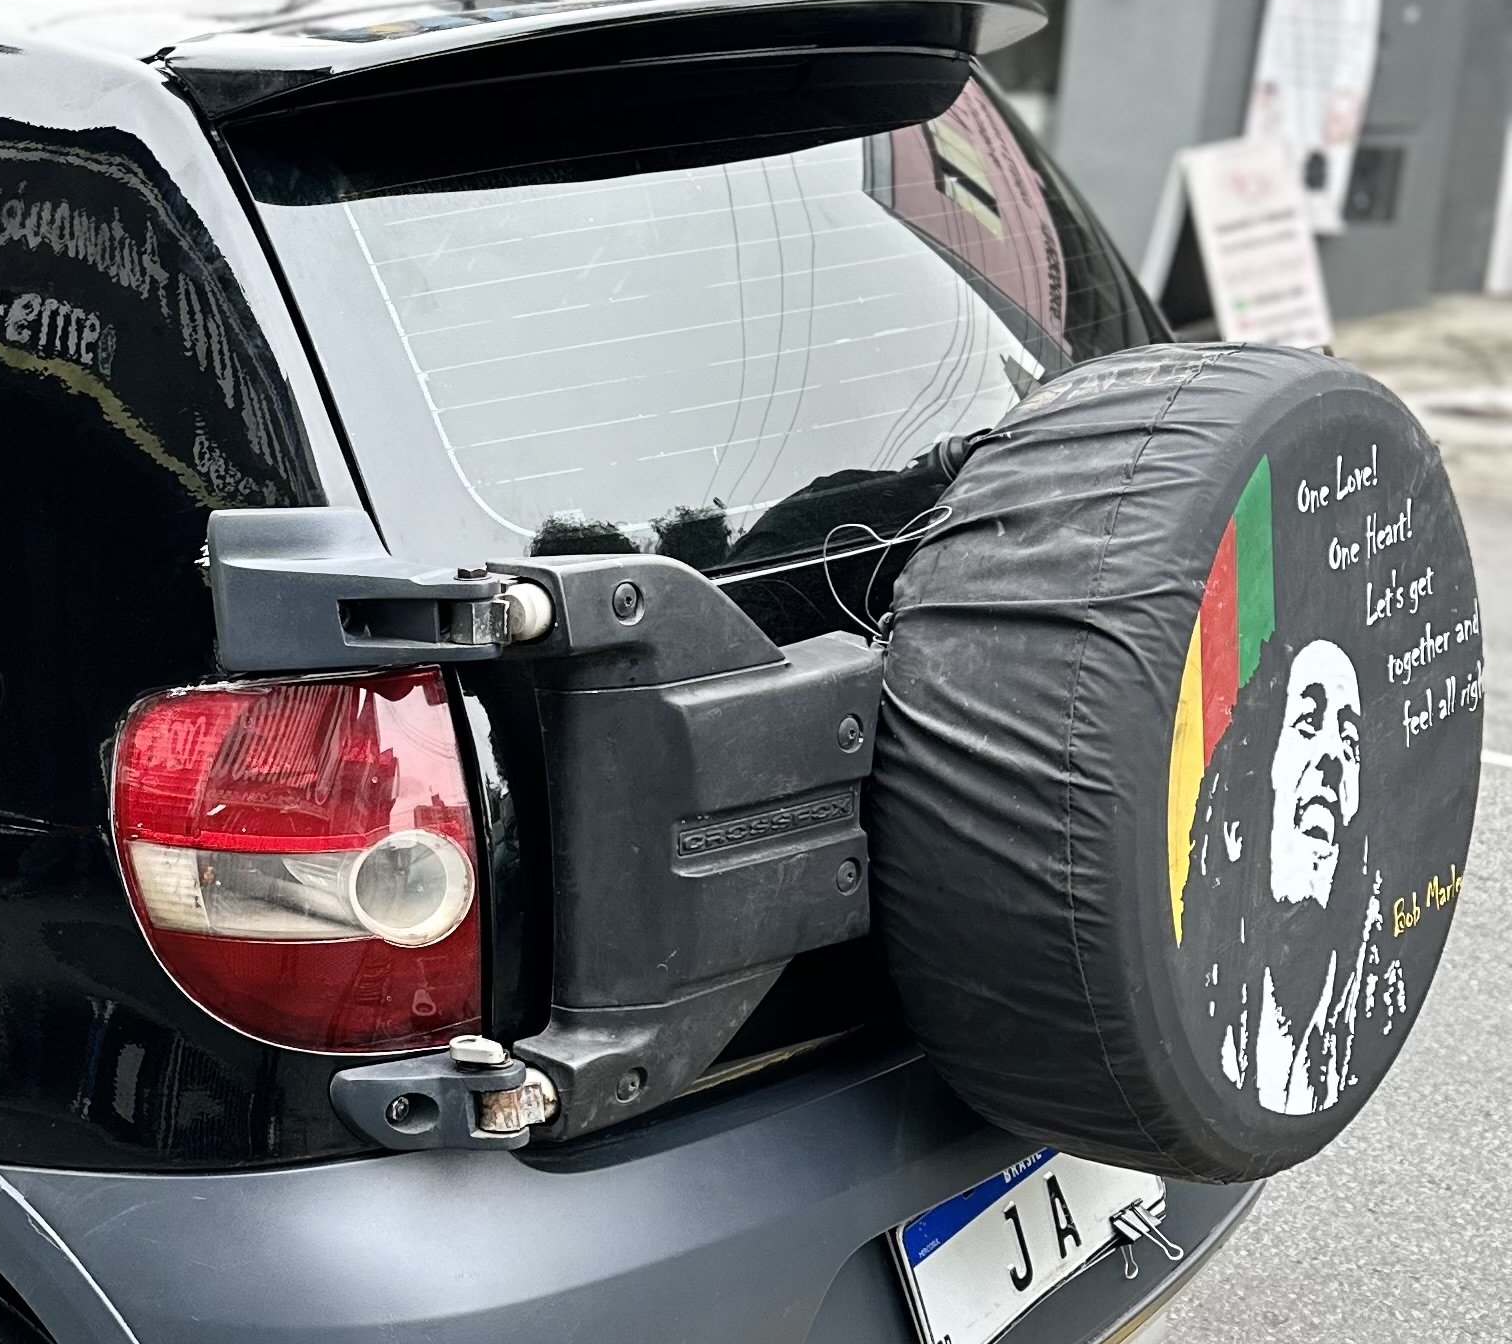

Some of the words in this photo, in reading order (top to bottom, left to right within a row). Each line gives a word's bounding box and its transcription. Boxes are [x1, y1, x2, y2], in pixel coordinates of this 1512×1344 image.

[1297, 479, 1329, 514] One
[1336, 444, 1379, 501] Love!
[1328, 537, 1360, 570] One
[1366, 498, 1413, 559] Heart!
[1366, 569, 1404, 626] Let's
[1409, 566, 1435, 614] get
[1388, 622, 1451, 685] together
[1455, 598, 1480, 644] and
[1402, 688, 1433, 748] feel
[1439, 675, 1457, 720] all
[1460, 659, 1483, 712] righ
[682, 794, 852, 853] CROSSFOX
[1393, 891, 1420, 937] Bob
[1426, 863, 1464, 911] Marle
